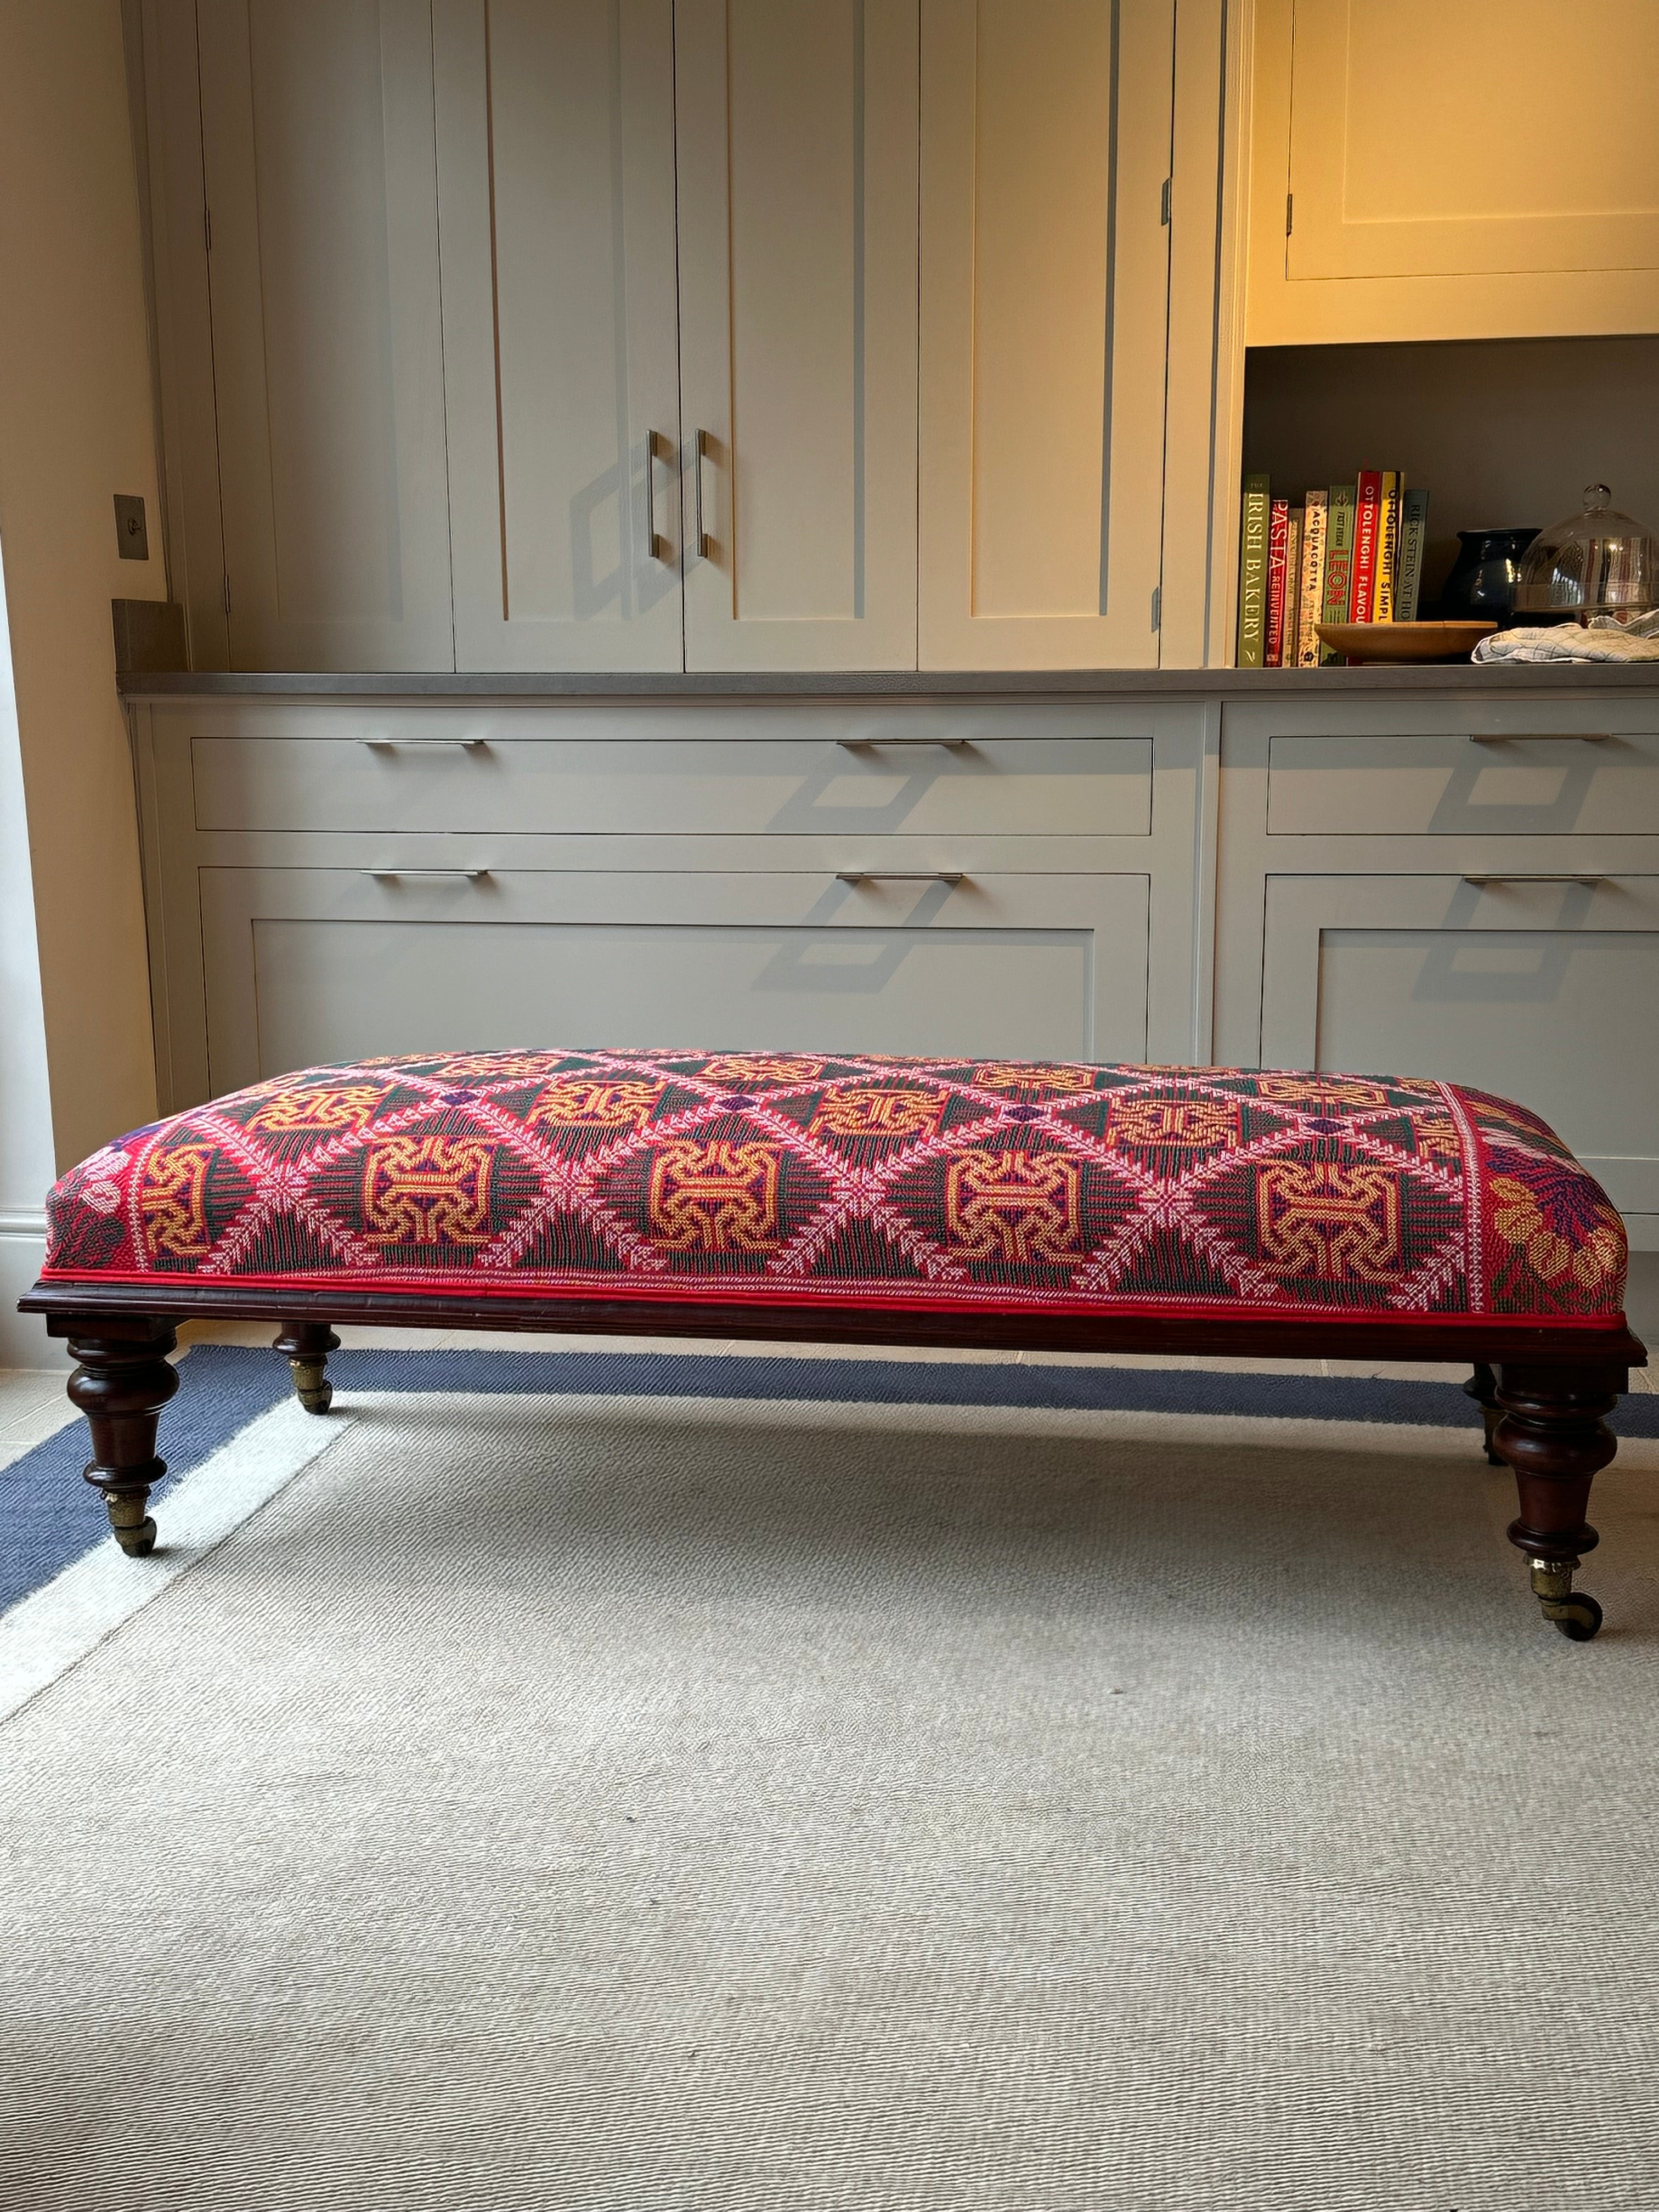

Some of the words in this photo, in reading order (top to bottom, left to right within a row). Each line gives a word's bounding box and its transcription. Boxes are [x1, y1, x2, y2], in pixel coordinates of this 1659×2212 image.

[1247, 493, 1263, 550] IRISH
[1269, 499, 1288, 569] PASTA
[1309, 511, 1321, 591] ACQUACOTTA
[1359, 486, 1374, 569] OTTOLENGHI
[1383, 489, 1396, 575] OTTOLENGHI
[1408, 505, 1420, 535] RICK
[1327, 550, 1348, 605] LEON
[1403, 580, 1414, 599] AT
[1405, 538, 1417, 577] STEIN
[1244, 559, 1261, 642] BAKERY
[1269, 575, 1281, 644] REINVENTED
